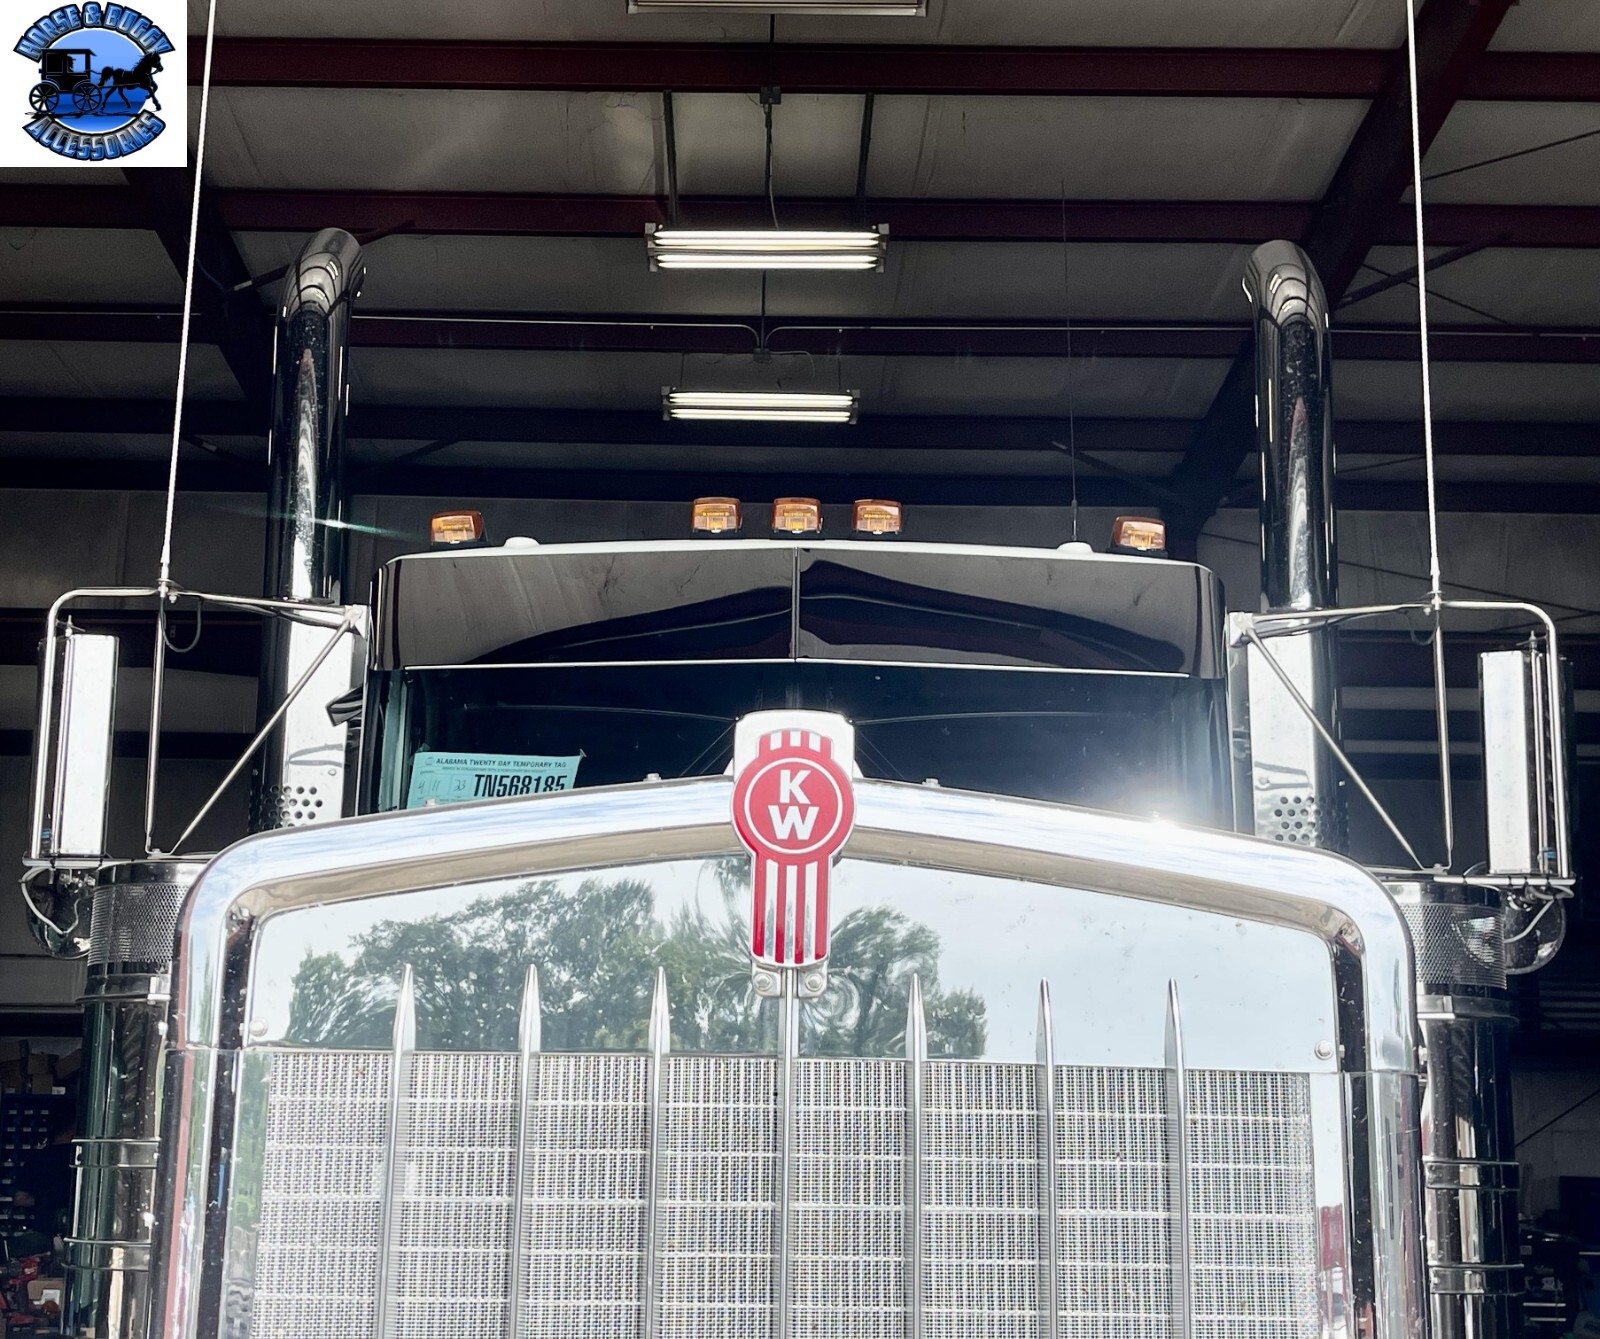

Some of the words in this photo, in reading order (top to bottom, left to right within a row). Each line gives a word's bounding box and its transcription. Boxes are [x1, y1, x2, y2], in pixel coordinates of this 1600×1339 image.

[436, 758, 468, 766] ALABAMA
[469, 759, 496, 767] TWENTY
[473, 774, 568, 798] TN568185
[779, 769, 812, 804] K
[767, 805, 820, 840] W
